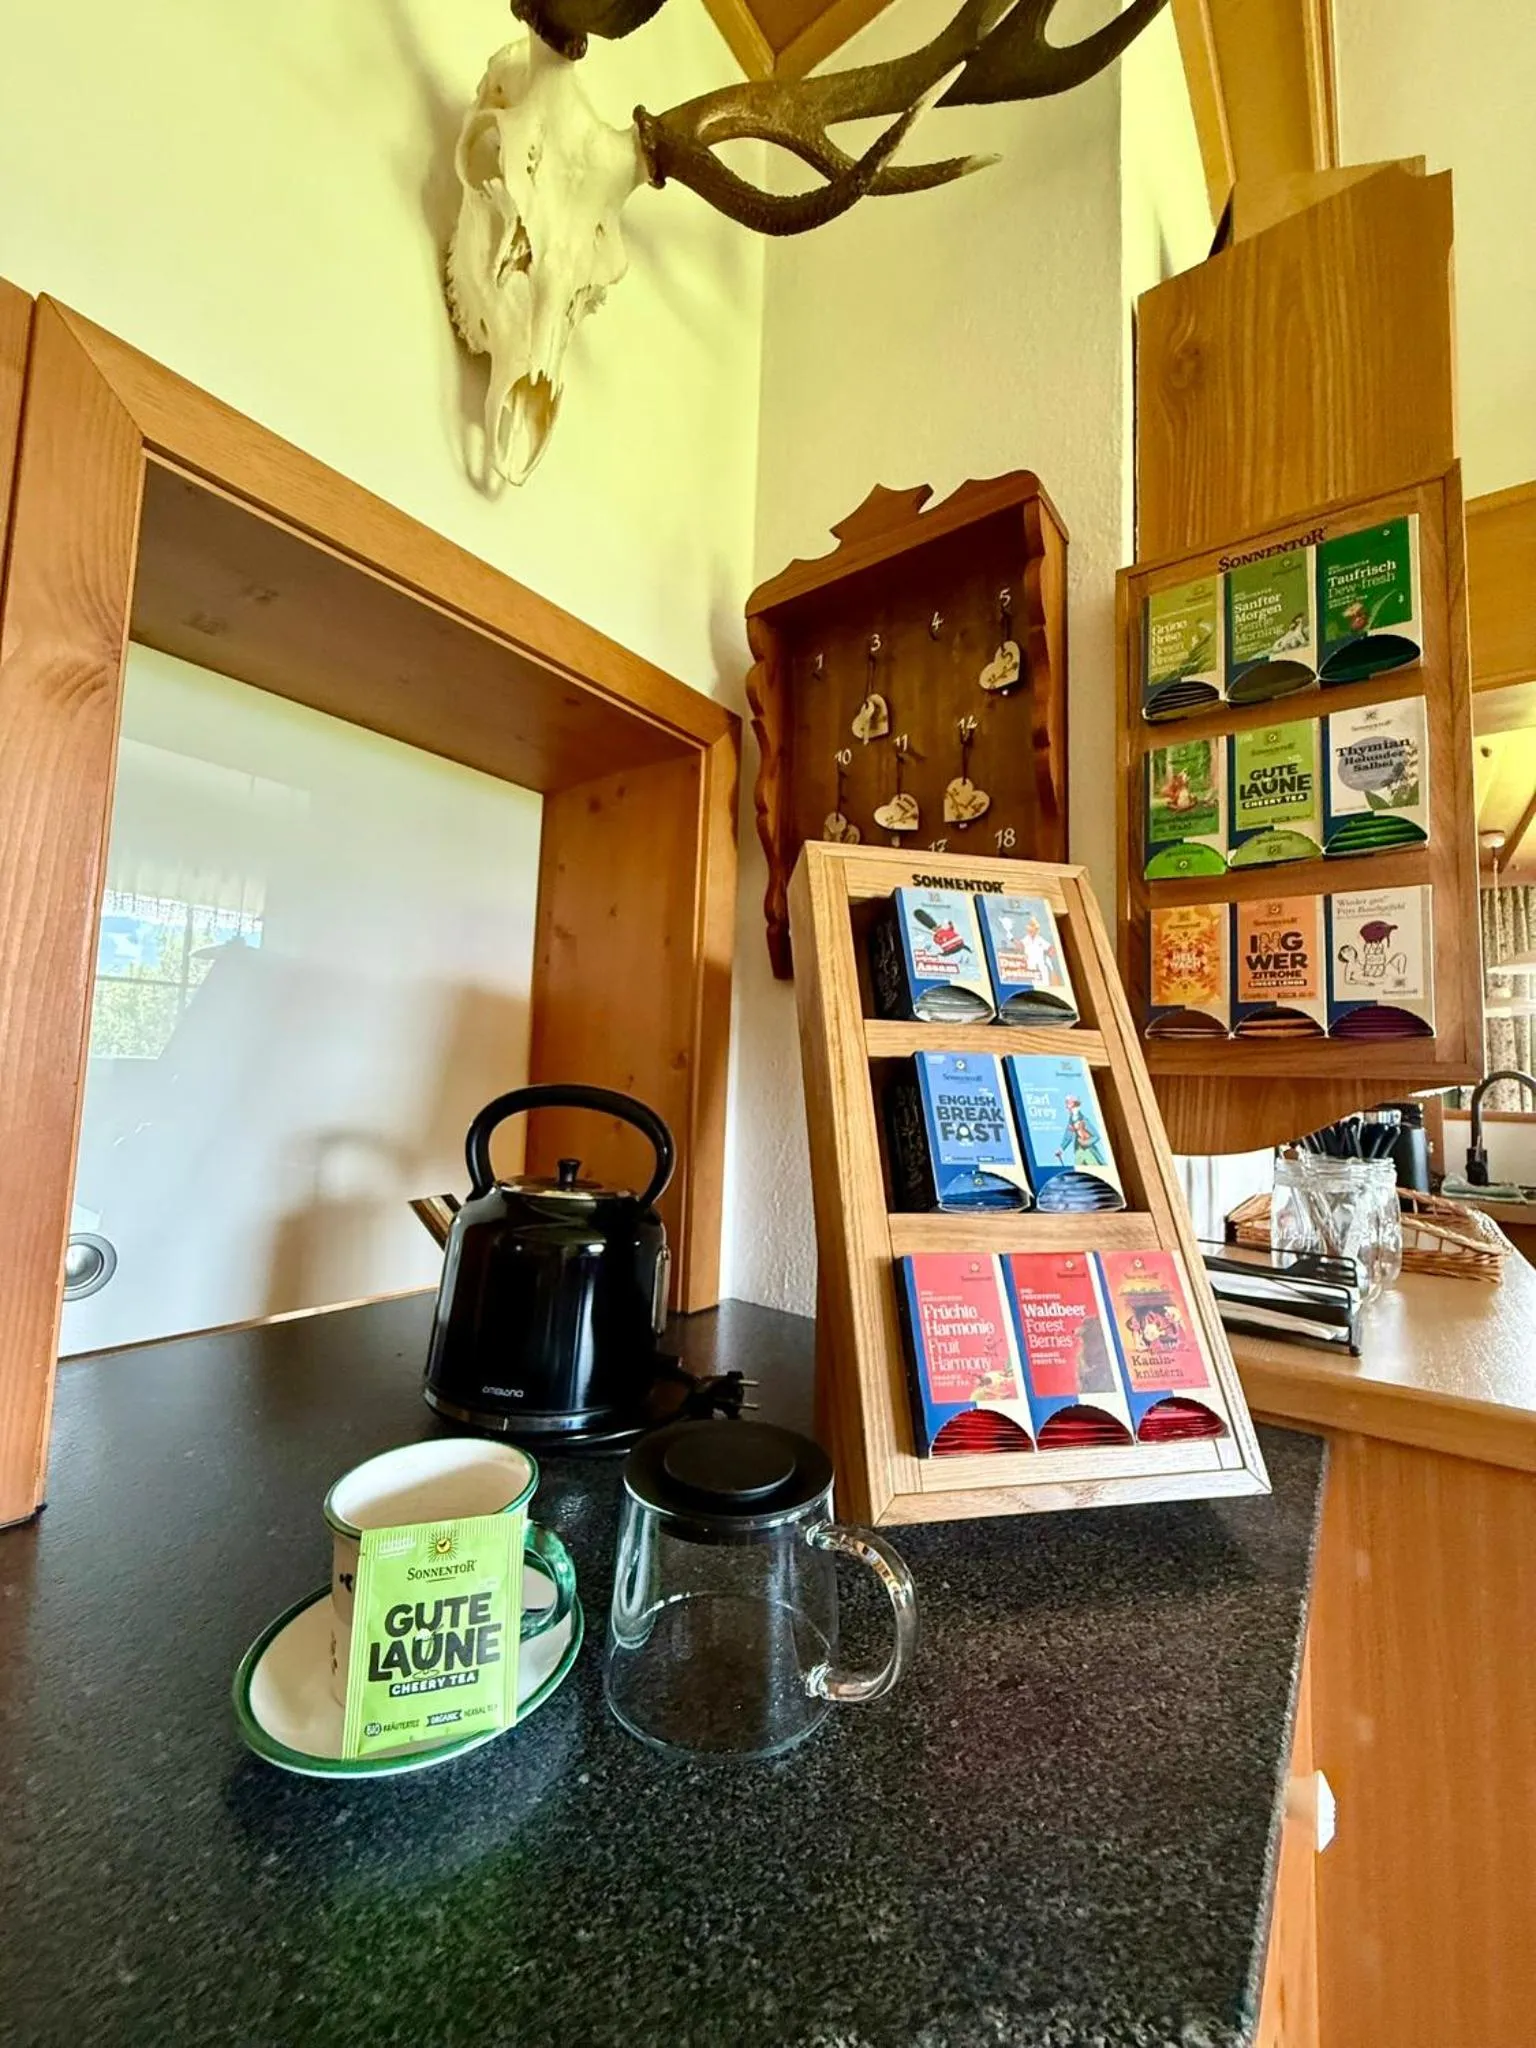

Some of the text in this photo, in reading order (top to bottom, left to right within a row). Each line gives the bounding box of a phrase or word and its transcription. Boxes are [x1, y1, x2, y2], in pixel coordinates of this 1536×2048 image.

[1328, 559, 1397, 588] Taufrisch
[1000, 588, 1011, 607] 5
[1234, 593, 1281, 613] Sanfter
[931, 611, 944, 631] 4
[1234, 604, 1282, 624] Morgen
[871, 634, 882, 651] 3
[835, 749, 852, 765] 10
[1336, 738, 1410, 758] Thymian
[1345, 750, 1406, 766] Holunder
[1353, 759, 1394, 773] Salbei
[1250, 763, 1298, 781] GUTE
[1240, 774, 1312, 801] LAUNE
[994, 828, 1016, 848] 18
[912, 873, 1004, 894] SONNENTOR
[1250, 931, 1304, 954] ING
[1245, 952, 1309, 971] WER
[1251, 970, 1302, 979] ZITRONE
[938, 1094, 997, 1107] ENGLISH
[1027, 1093, 1050, 1105] Earl
[936, 1106, 1004, 1122] BREAK
[1030, 1107, 1057, 1120] Grey
[940, 1121, 1004, 1142] FAST
[923, 1304, 978, 1321] Früchte
[1022, 1302, 1086, 1317] Waldbeer
[925, 1319, 996, 1337] Harmonie
[1024, 1318, 1064, 1334] Forest
[928, 1338, 960, 1355] Fruit
[930, 1352, 992, 1373] Harmony
[1131, 1354, 1176, 1371] Kamin-
[406, 1559, 476, 1581] SONNENTOR
[384, 1591, 492, 1638] GUTE
[368, 1623, 502, 1682] LAUNE
[391, 1671, 477, 1696] CHEERY TEA
